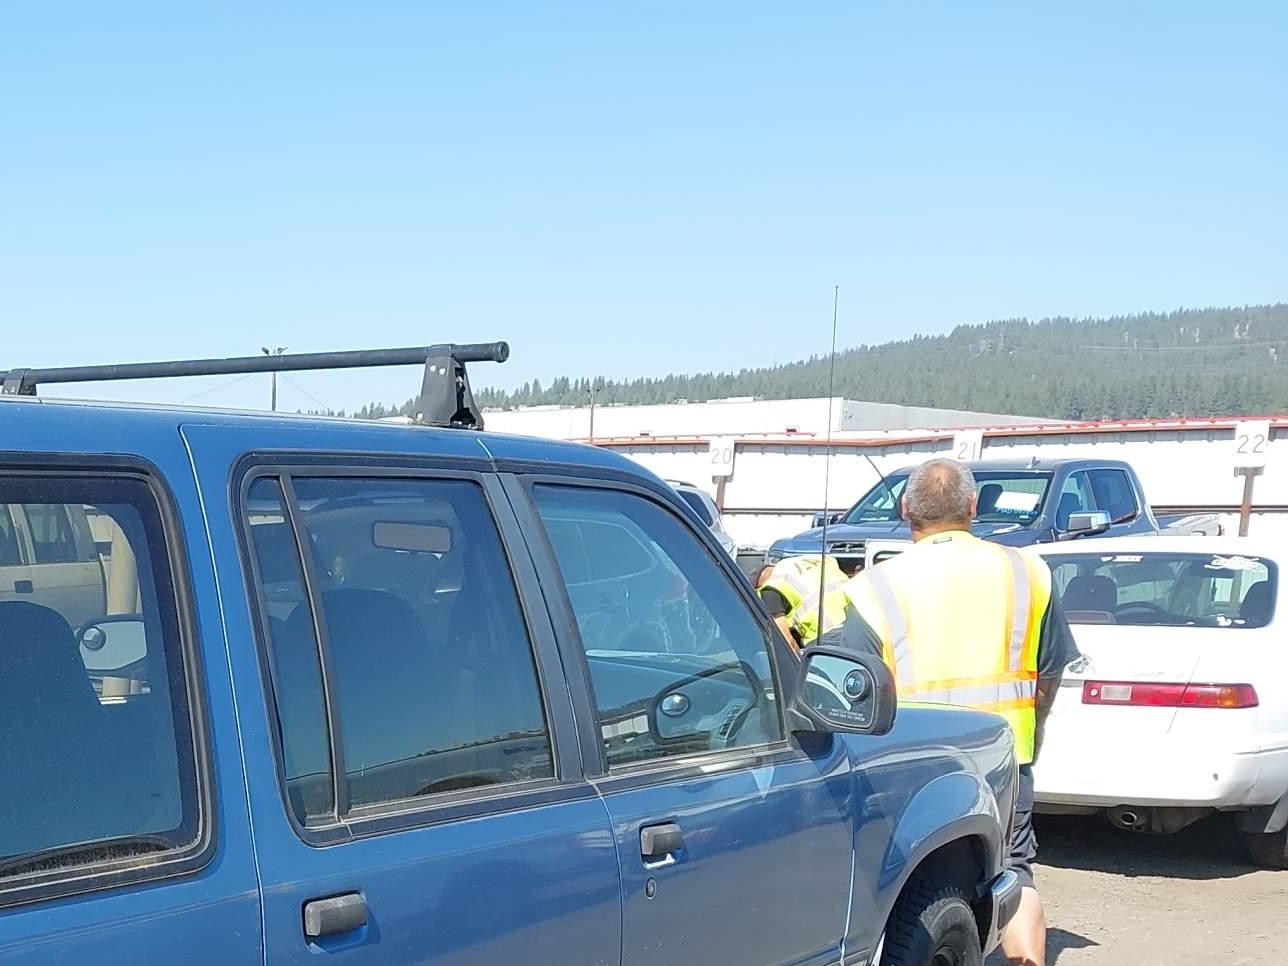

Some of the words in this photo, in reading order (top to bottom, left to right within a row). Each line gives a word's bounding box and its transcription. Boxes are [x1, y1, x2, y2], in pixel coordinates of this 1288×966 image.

[957, 442, 976, 460] 21
[1237, 433, 1265, 454] 22
[711, 447, 732, 464] 20
